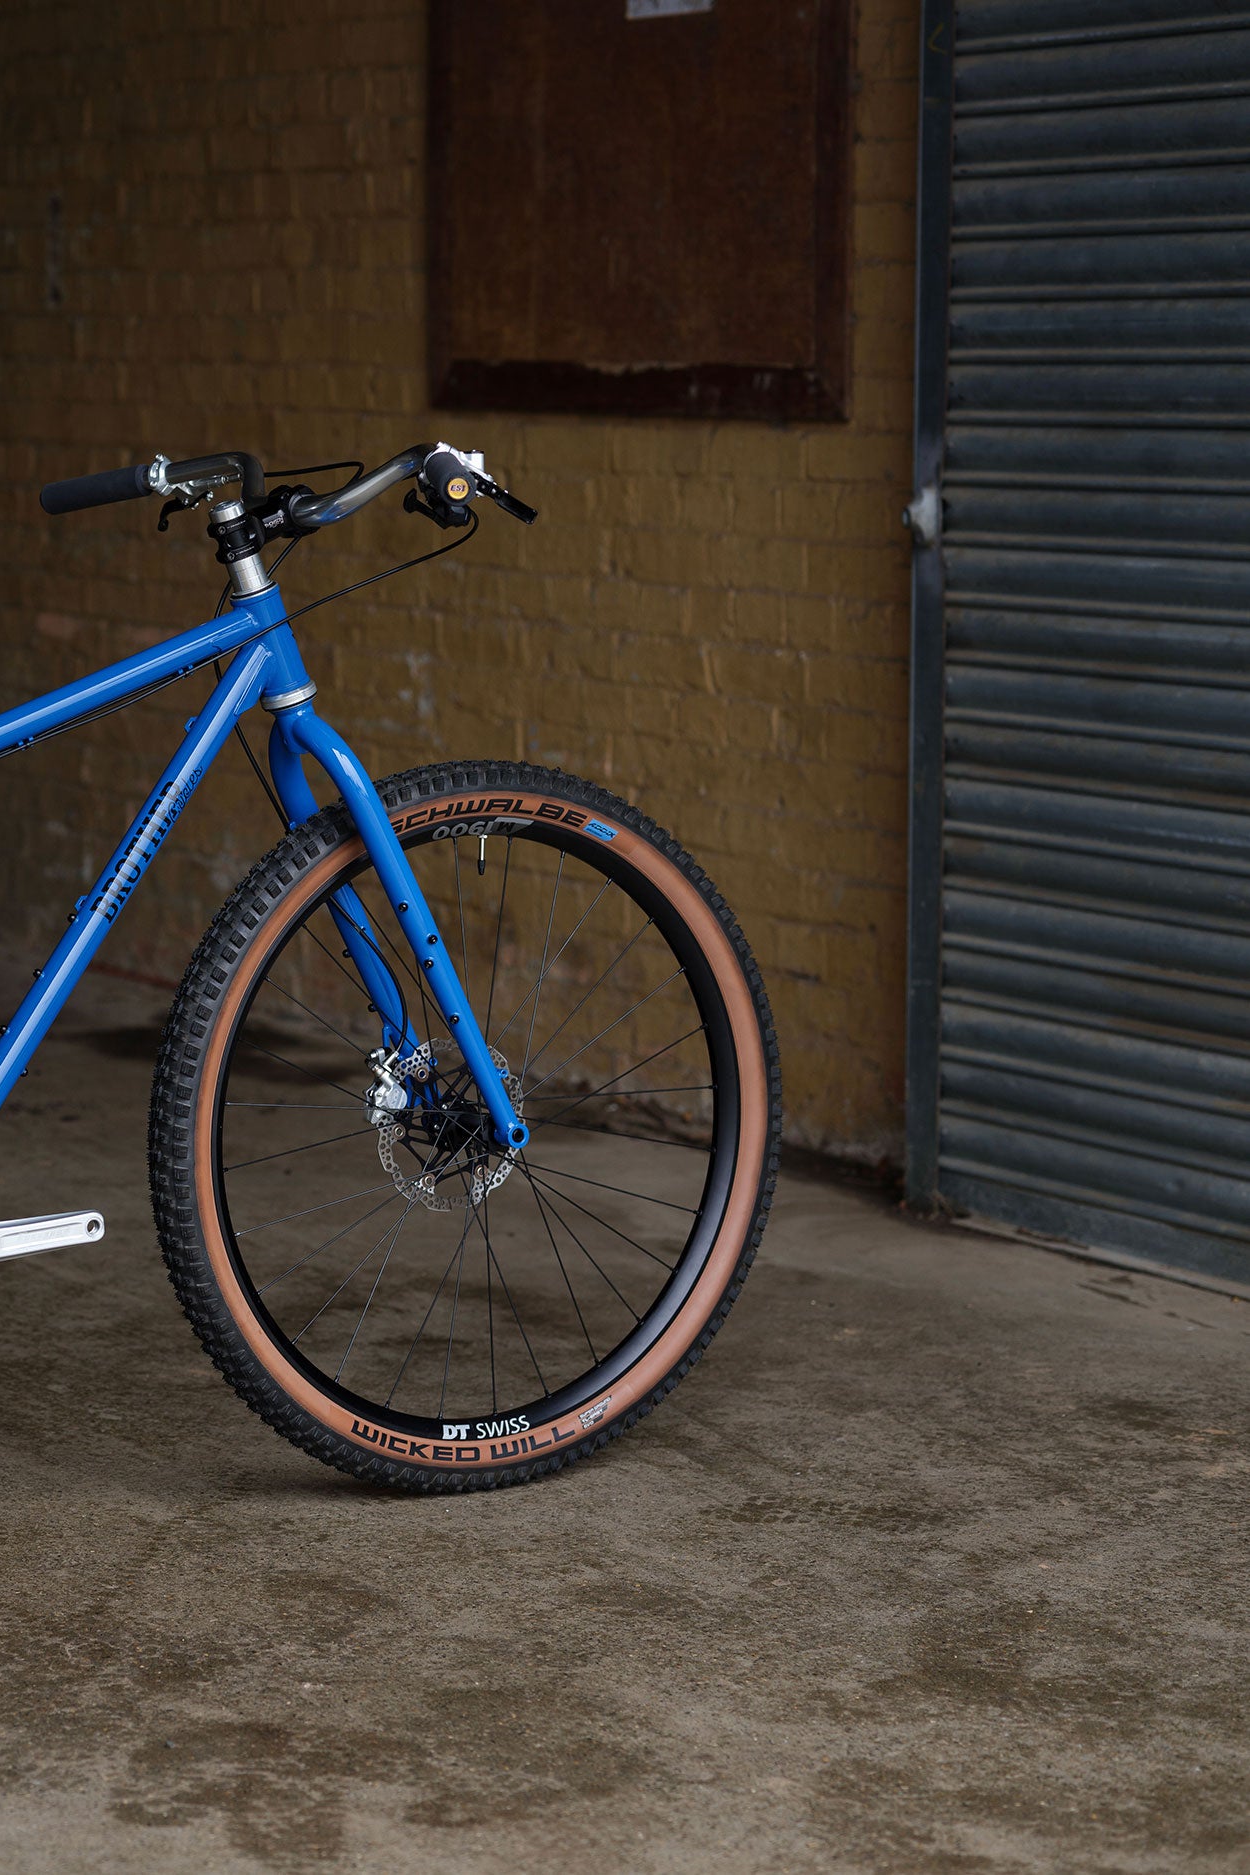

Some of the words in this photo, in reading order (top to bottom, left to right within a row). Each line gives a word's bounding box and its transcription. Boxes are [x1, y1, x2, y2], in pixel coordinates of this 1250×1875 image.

[350, 1420, 481, 1462] WICKED
[490, 1426, 576, 1461] WILL
[442, 1424, 471, 1440] DT
[475, 1415, 531, 1440] SWISS
